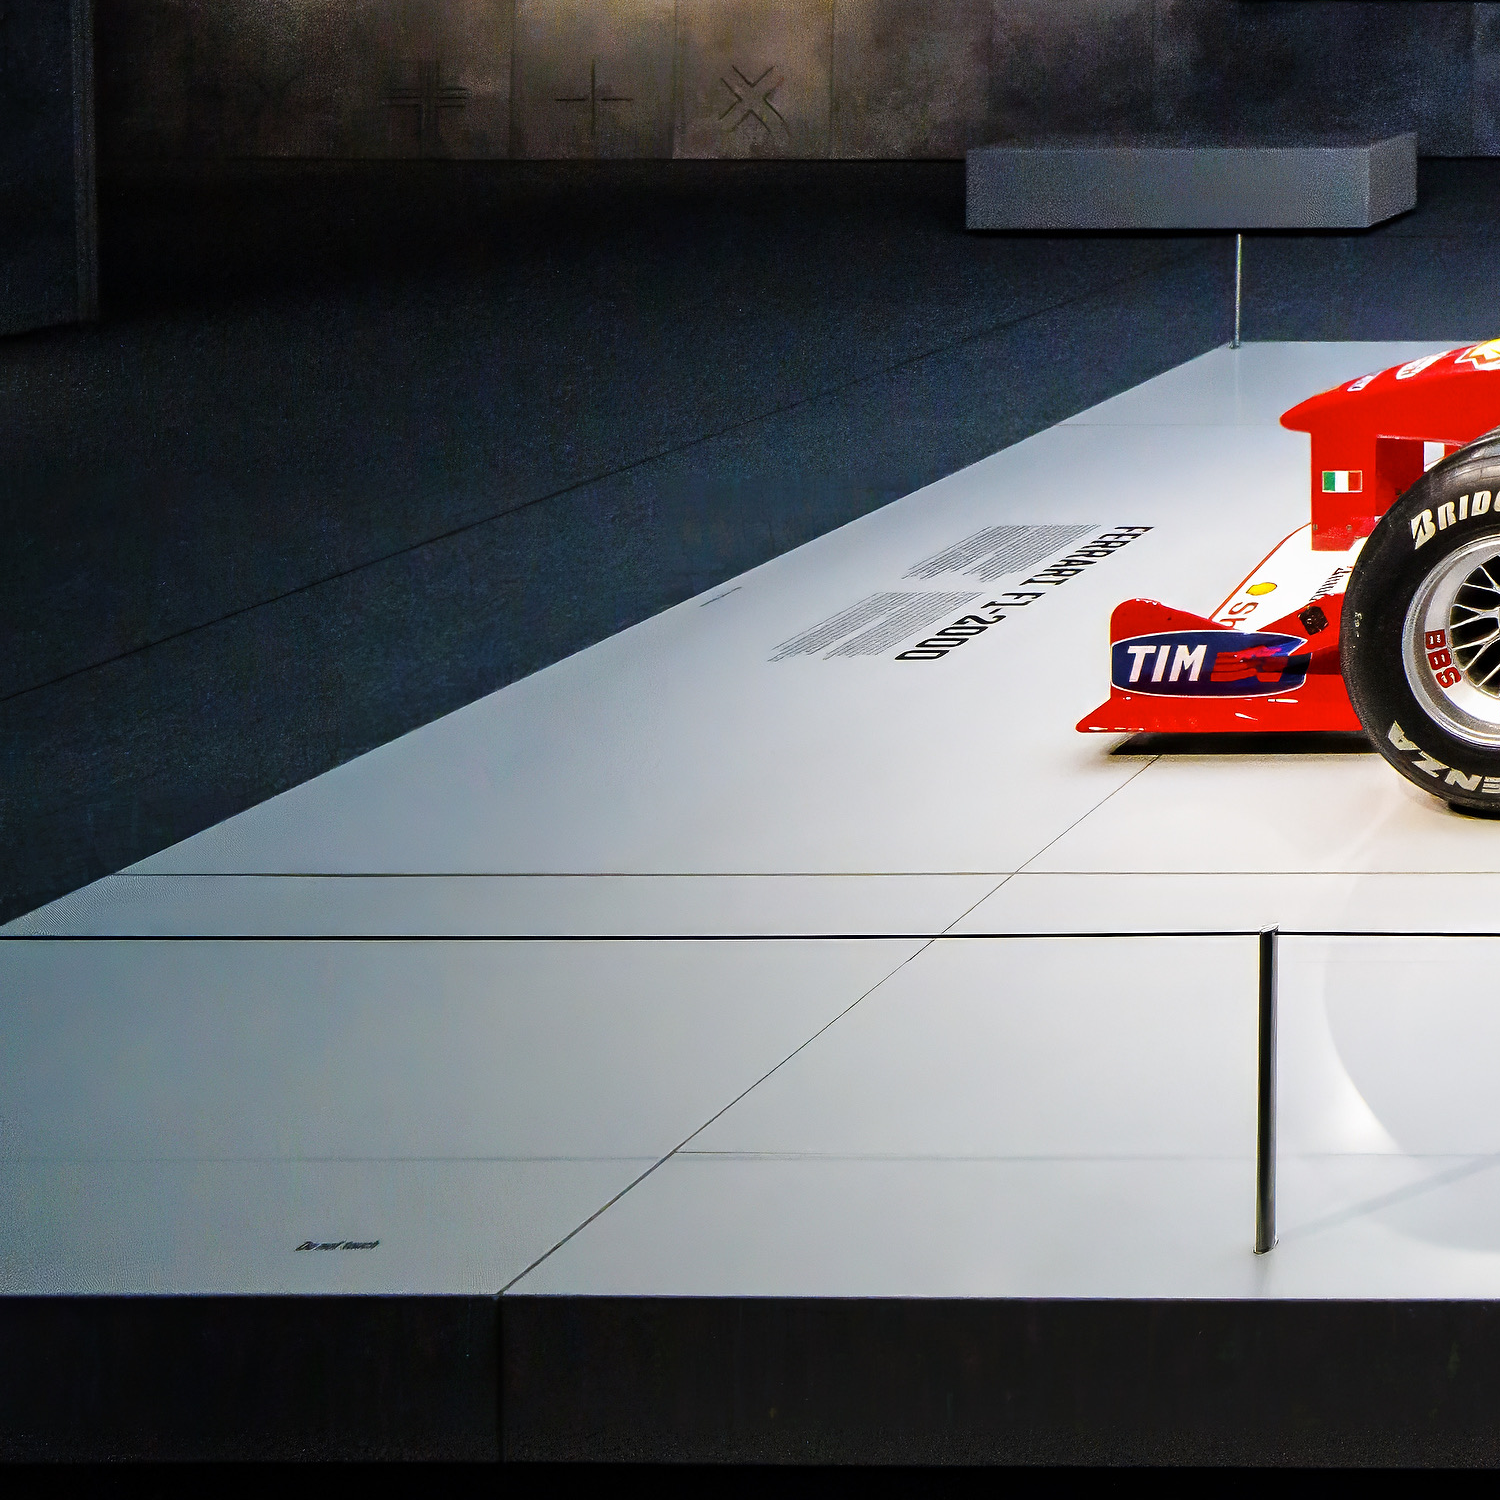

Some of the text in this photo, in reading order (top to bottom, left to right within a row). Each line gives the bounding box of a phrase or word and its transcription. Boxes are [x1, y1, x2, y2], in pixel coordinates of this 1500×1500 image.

[1018, 525, 1155, 587] FERRARI
[1127, 644, 1208, 683] TIM
[1425, 629, 1462, 688] BBS
